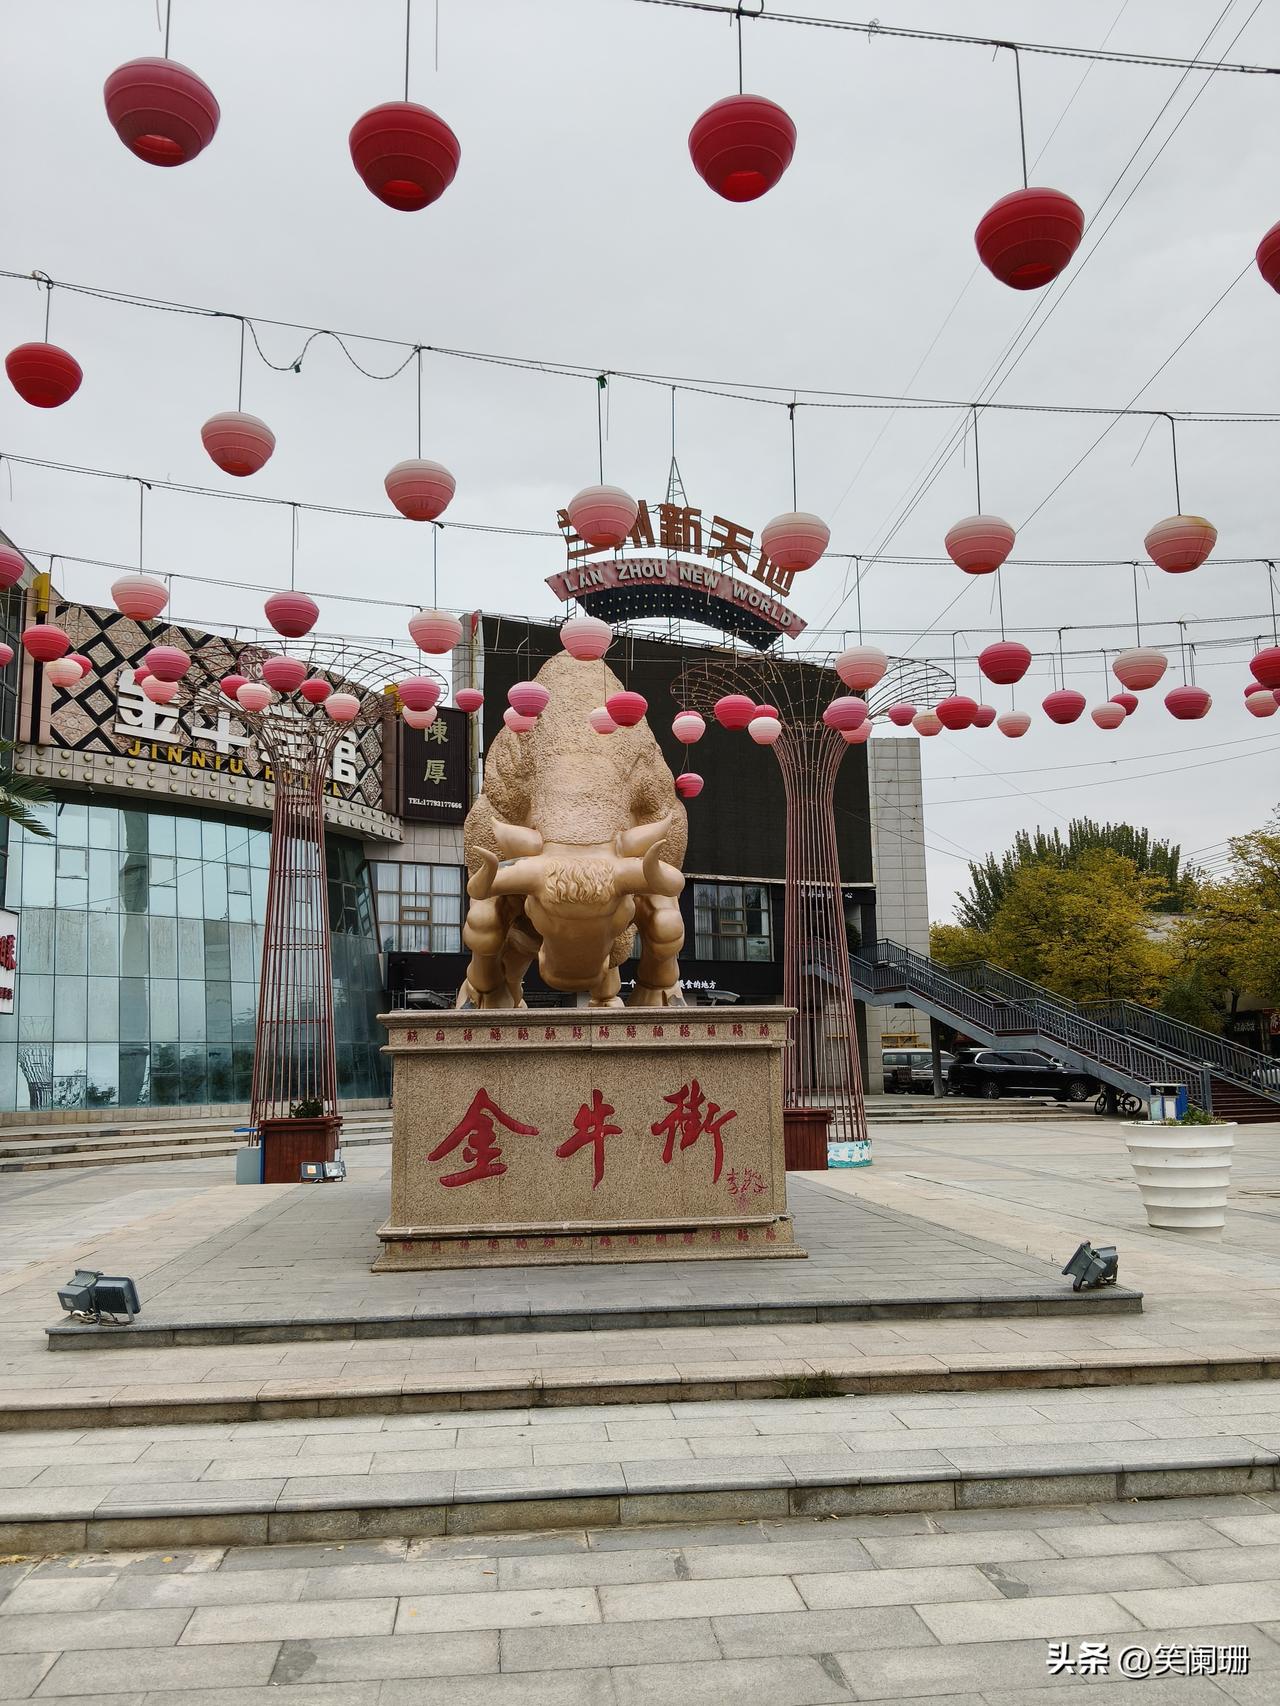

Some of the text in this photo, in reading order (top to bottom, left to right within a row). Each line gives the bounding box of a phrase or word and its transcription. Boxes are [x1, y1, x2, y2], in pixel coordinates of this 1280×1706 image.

[564, 561, 793, 627] LAN ZHOU NEW WORLD
[128, 740, 243, 774] JINNIU
[427, 1078, 737, 1191] 金牛街
